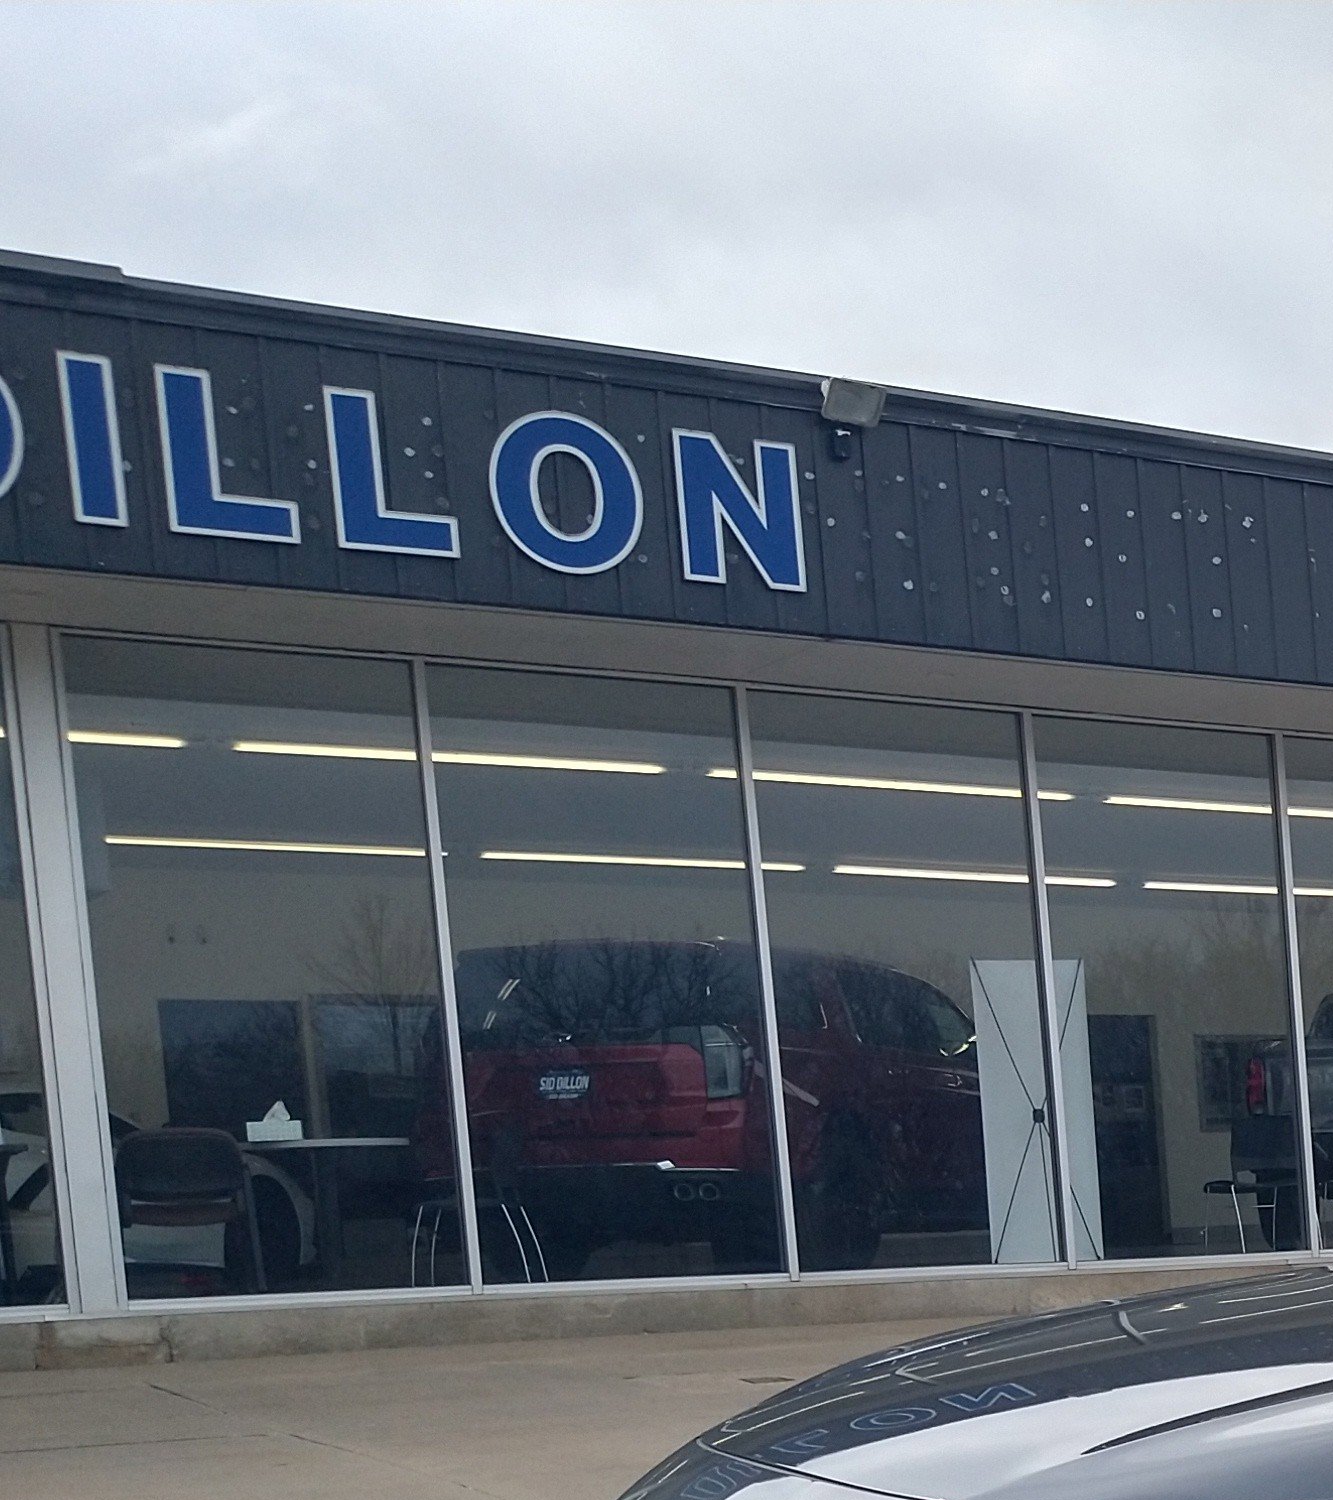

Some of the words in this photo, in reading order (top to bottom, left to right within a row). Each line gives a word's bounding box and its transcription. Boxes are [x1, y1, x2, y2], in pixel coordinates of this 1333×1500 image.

[0, 350, 807, 593] ILLON
[539, 1077, 555, 1091] SID
[556, 1075, 590, 1090] DILLON
